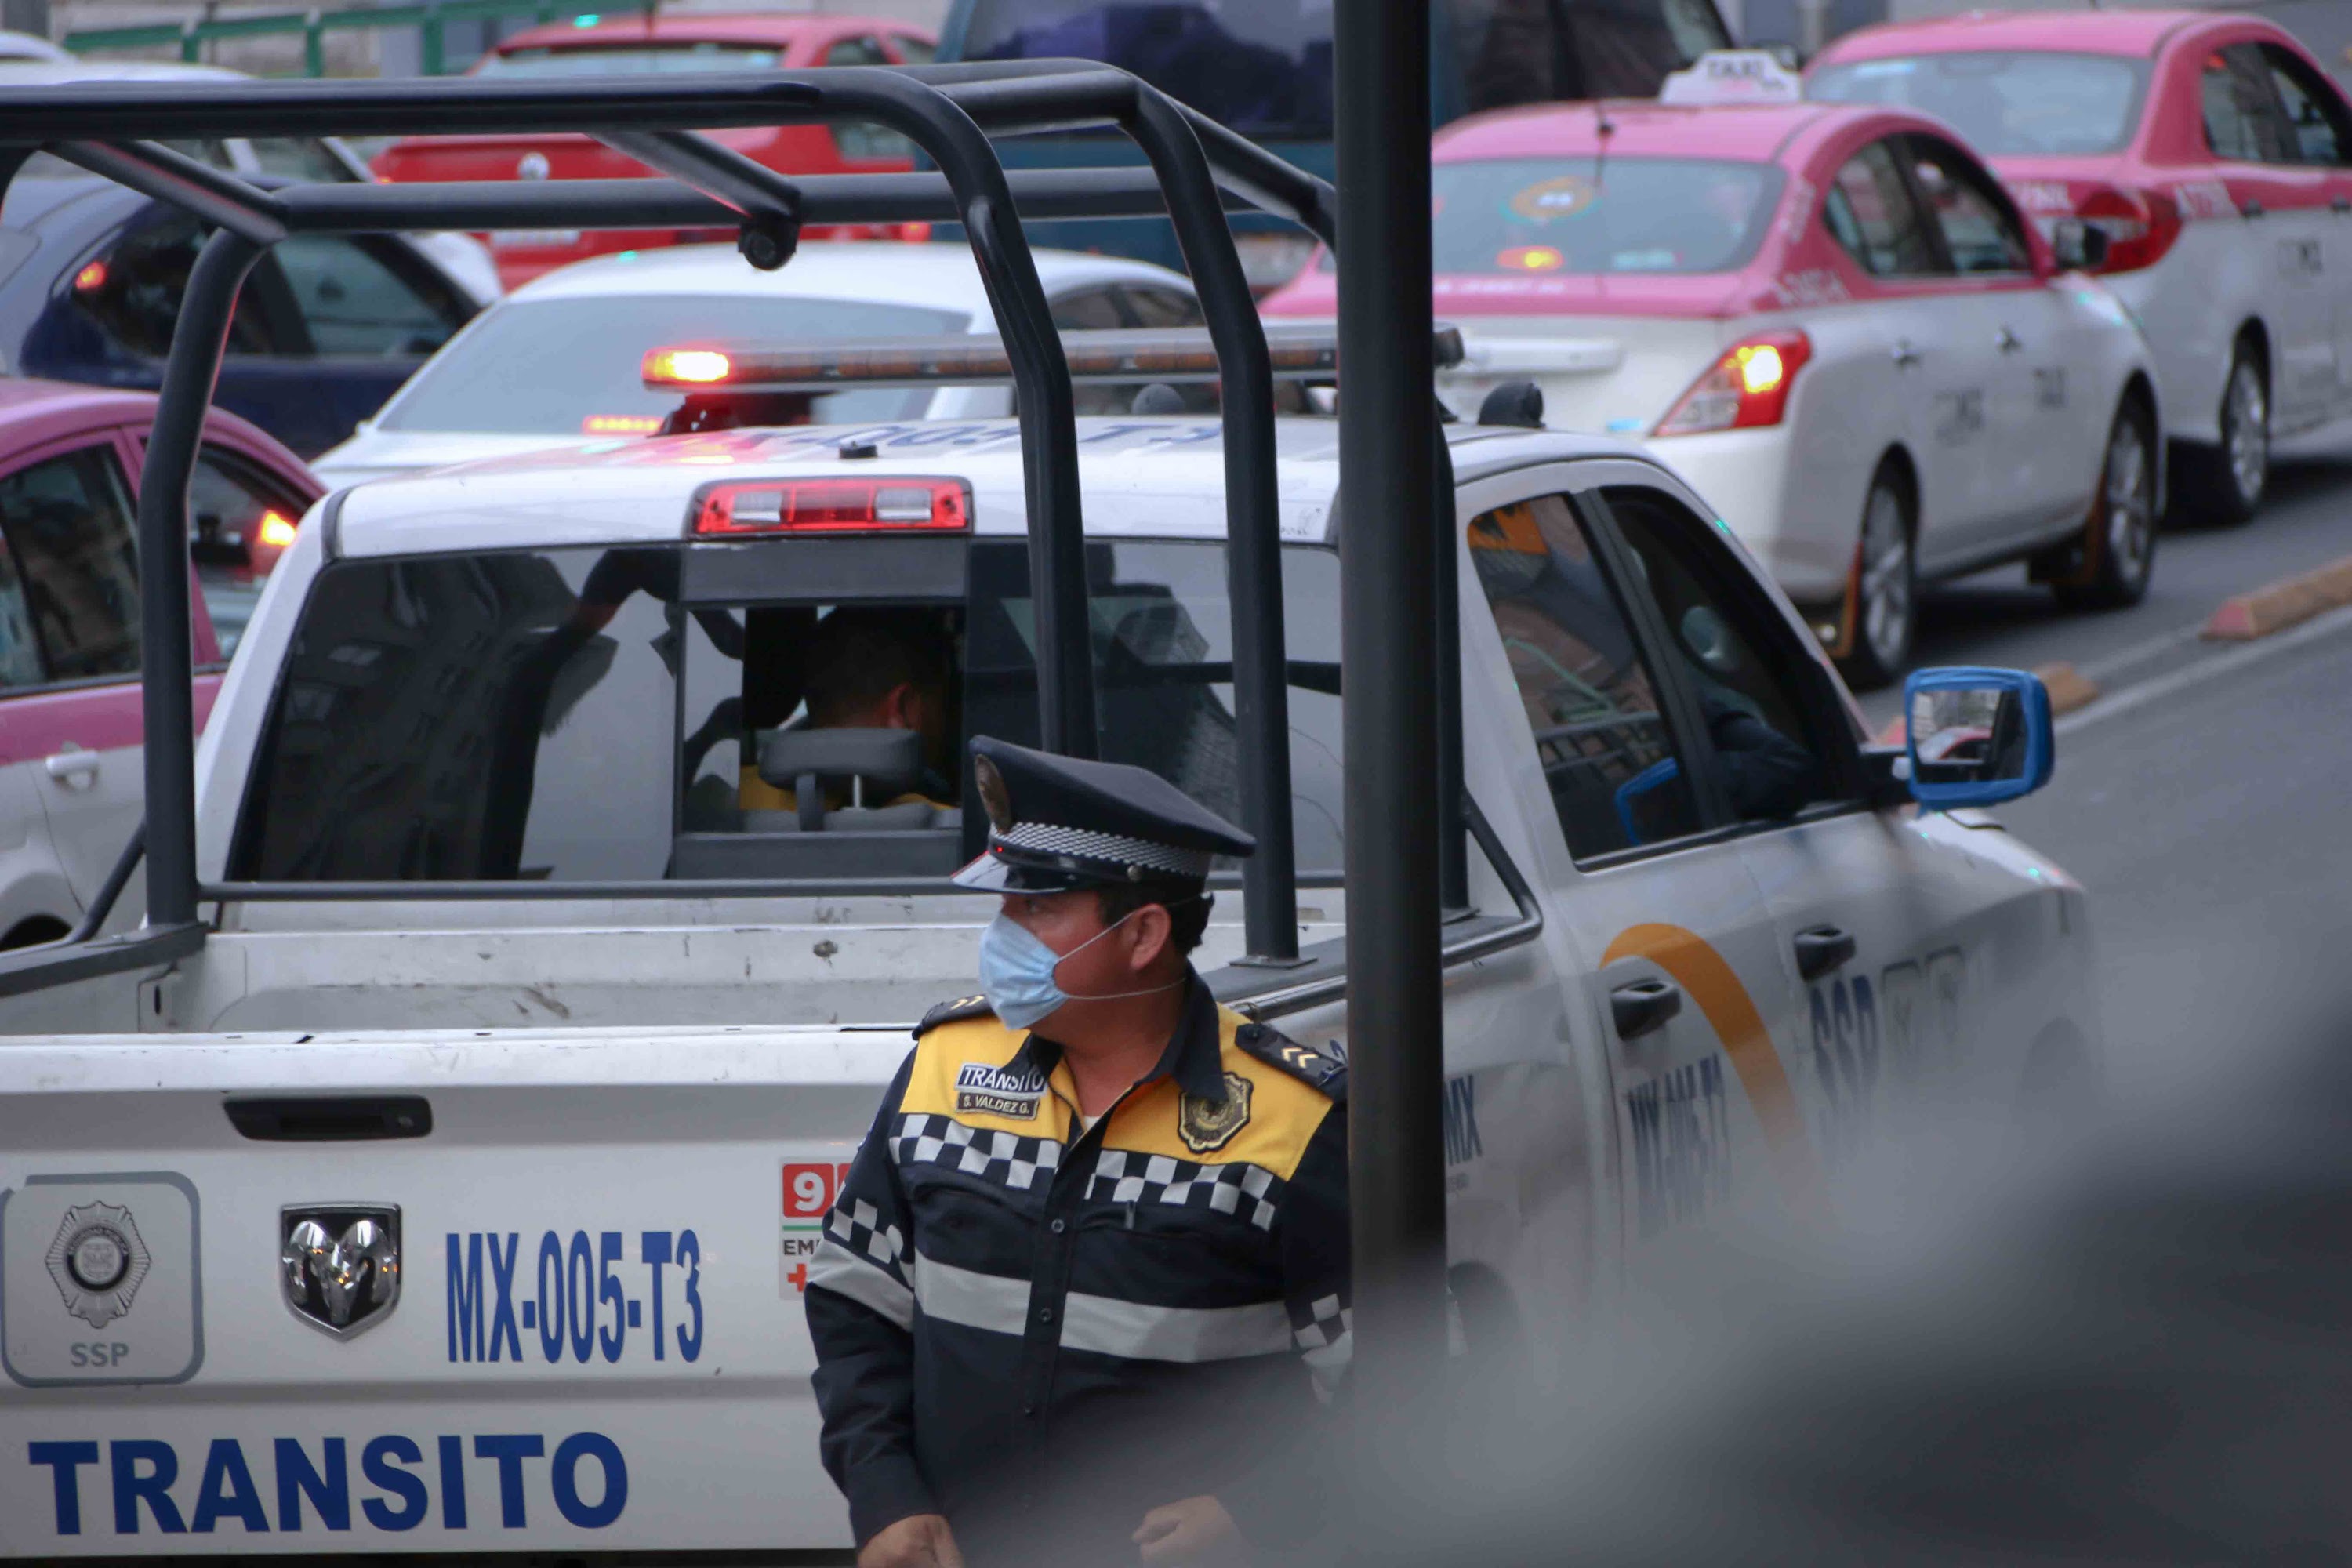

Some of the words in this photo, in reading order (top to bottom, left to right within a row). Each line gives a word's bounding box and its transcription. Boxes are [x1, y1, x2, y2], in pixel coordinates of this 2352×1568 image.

[975, 1095, 1019, 1113] VALDEZ
[1019, 1102, 1030, 1114] G.
[784, 1240, 820, 1255] EM
[446, 1229, 703, 1364] MX-005-T3
[71, 1342, 129, 1367] SSP
[28, 1432, 628, 1535] TRANSITO
